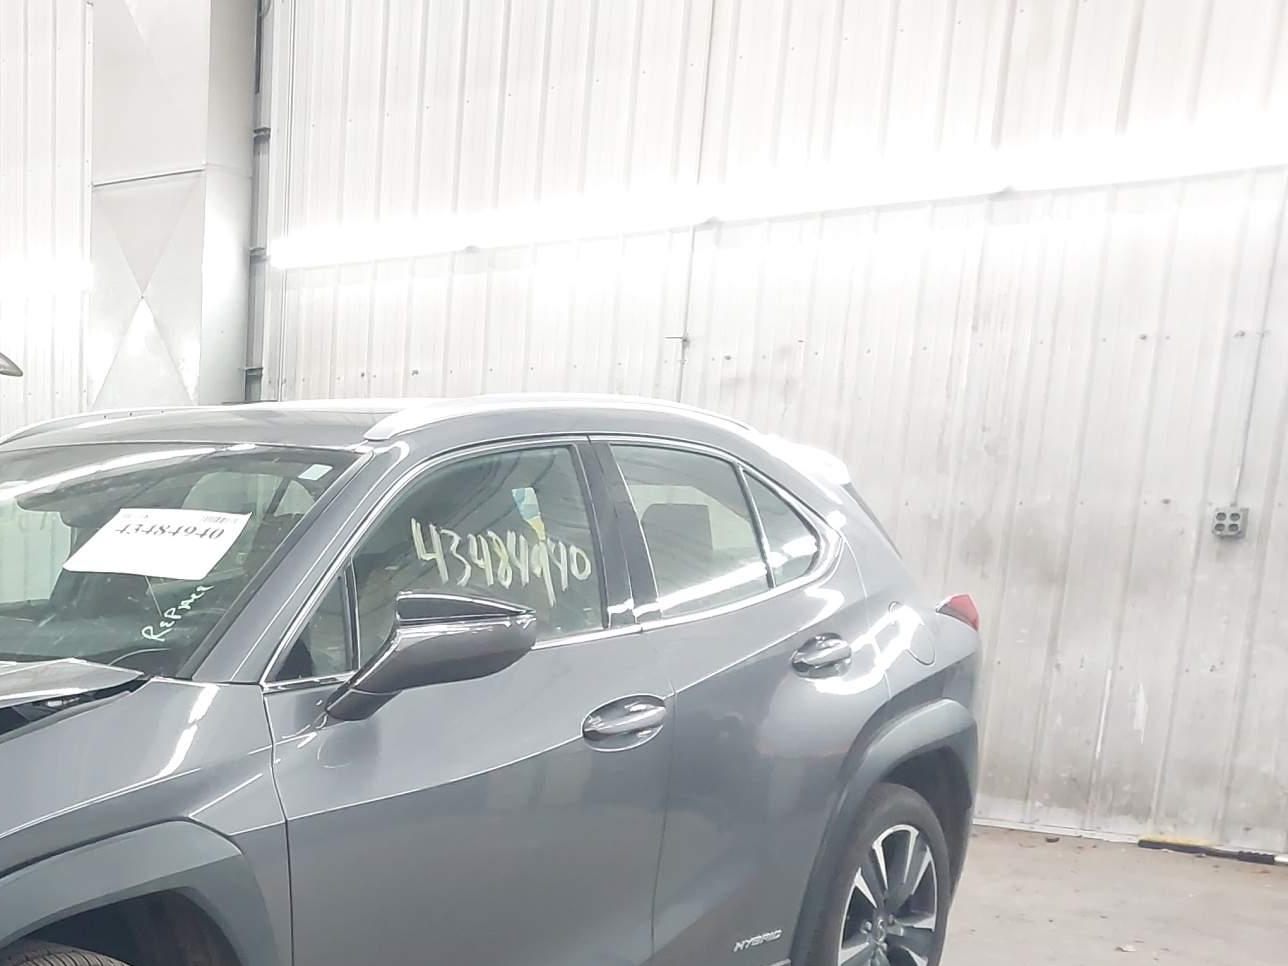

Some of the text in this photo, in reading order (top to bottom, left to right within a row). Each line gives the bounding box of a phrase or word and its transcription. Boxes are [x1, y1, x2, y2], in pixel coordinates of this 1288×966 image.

[115, 523, 224, 540] 43484940
[411, 517, 592, 607] 43484940
[733, 929, 782, 952] HYBRID
